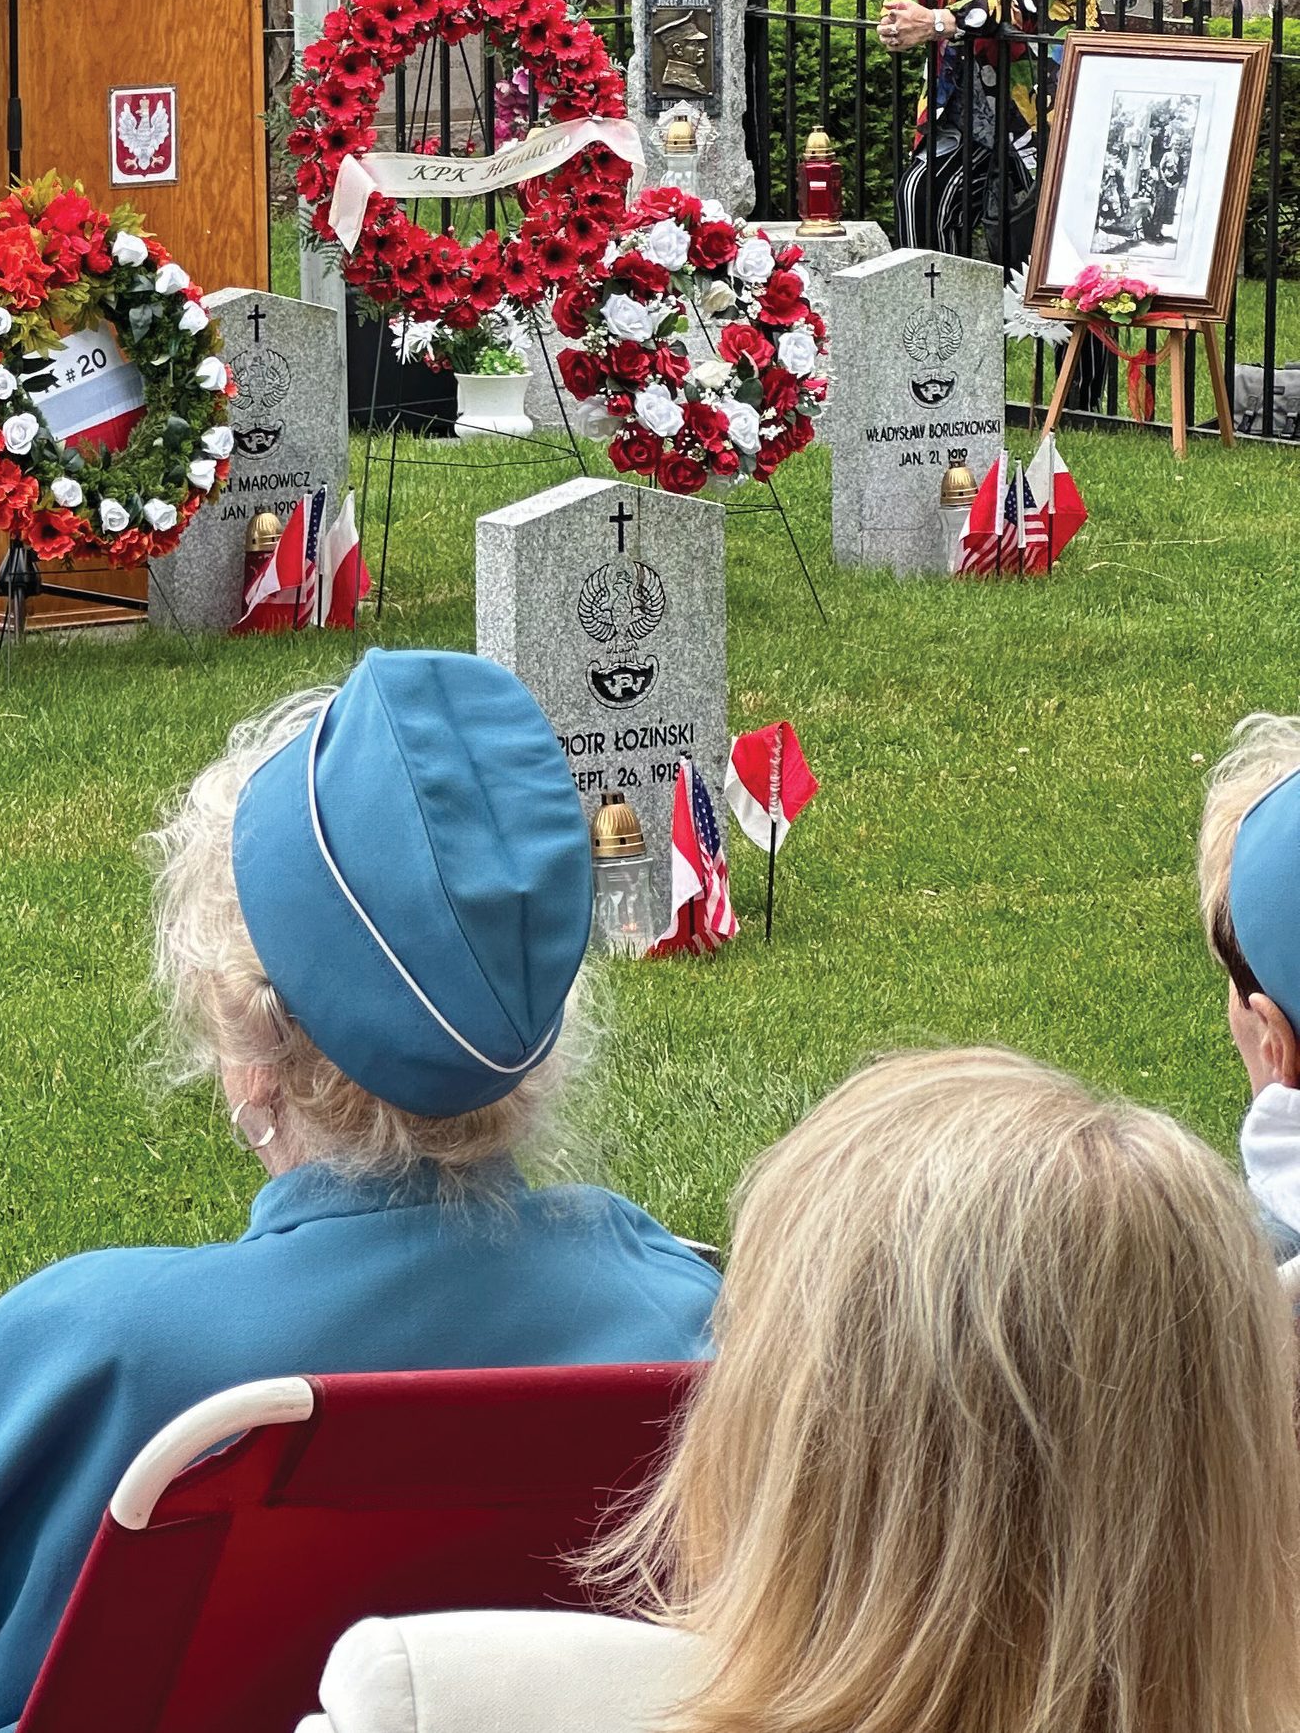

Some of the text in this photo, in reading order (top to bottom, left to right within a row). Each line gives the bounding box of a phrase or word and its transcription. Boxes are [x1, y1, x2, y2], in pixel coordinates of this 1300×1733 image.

[407, 133, 572, 183] KPK Hamilton
[865, 419, 1001, 443] WŁADYSŁAW BORUSZKOWSKI
[898, 451, 924, 467] JAN.
[238, 471, 311, 492] MAROWICZ
[220, 504, 249, 521] JAN.
[613, 717, 694, 752] ŁOZIŃSKI
[617, 767, 642, 788] 26,
[651, 761, 681, 784] 1918
